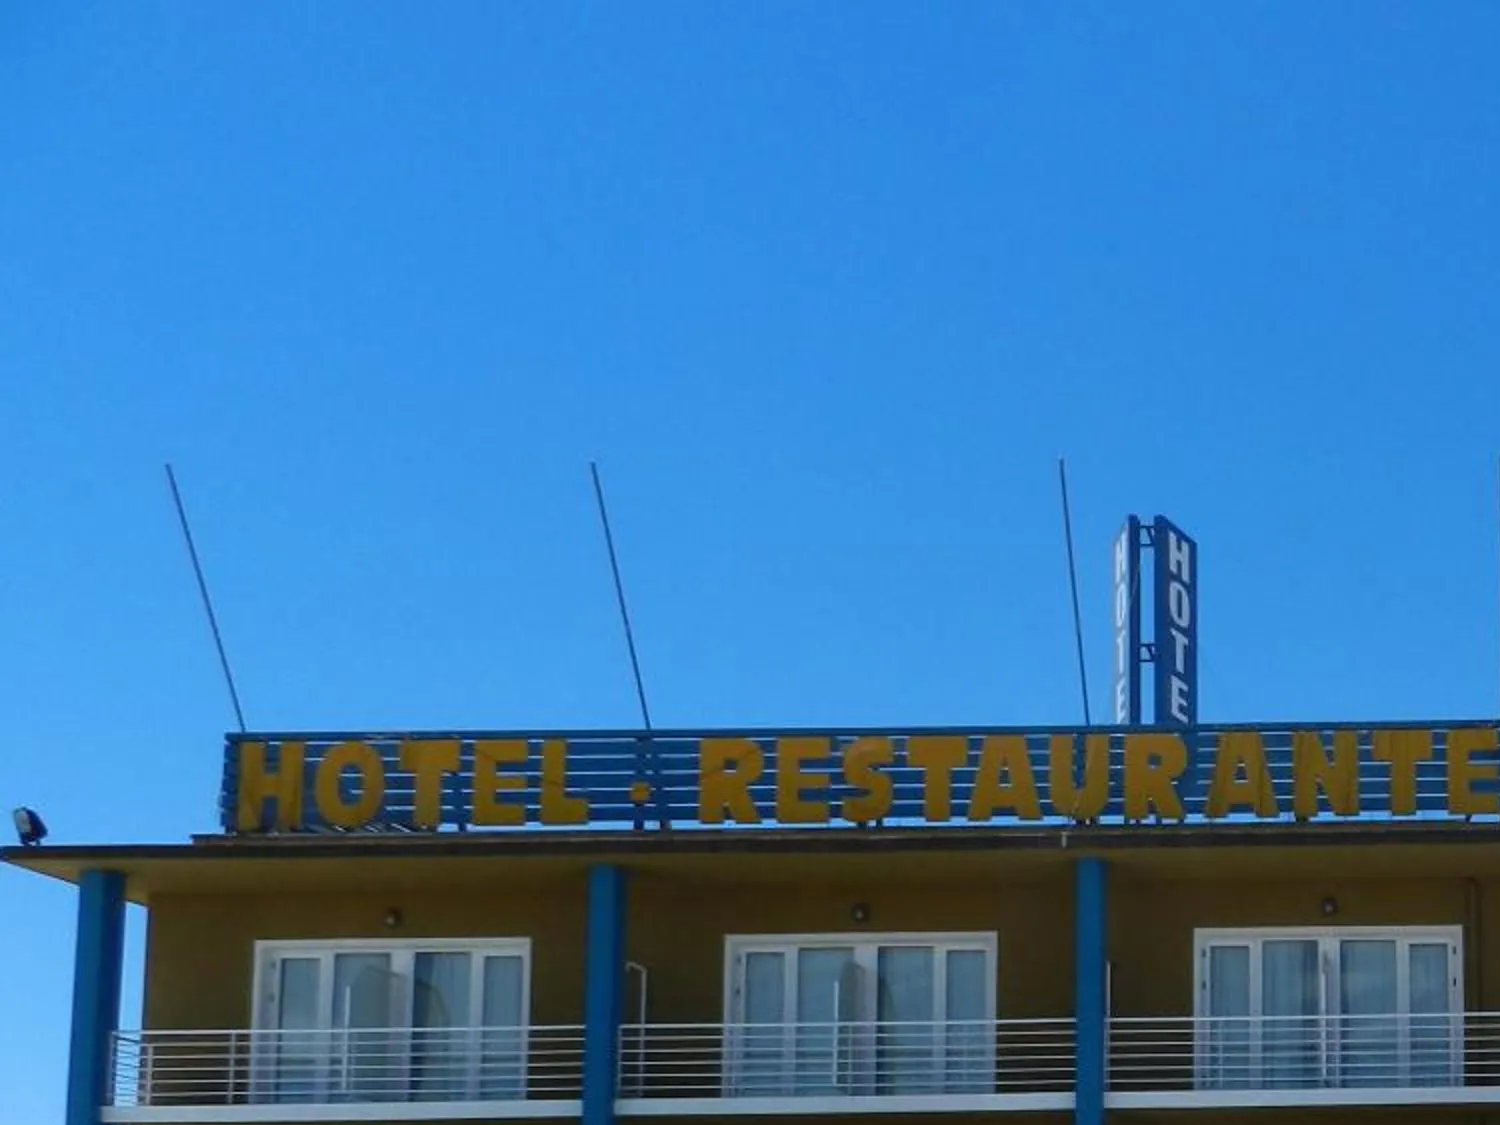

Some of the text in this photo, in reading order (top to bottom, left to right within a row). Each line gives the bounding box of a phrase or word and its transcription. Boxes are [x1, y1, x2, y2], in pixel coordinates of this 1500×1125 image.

[1115, 530, 1128, 725] HOTE
[1168, 531, 1190, 724] HOTE
[236, 729, 1500, 830] HOTEL RESTAURANTE
